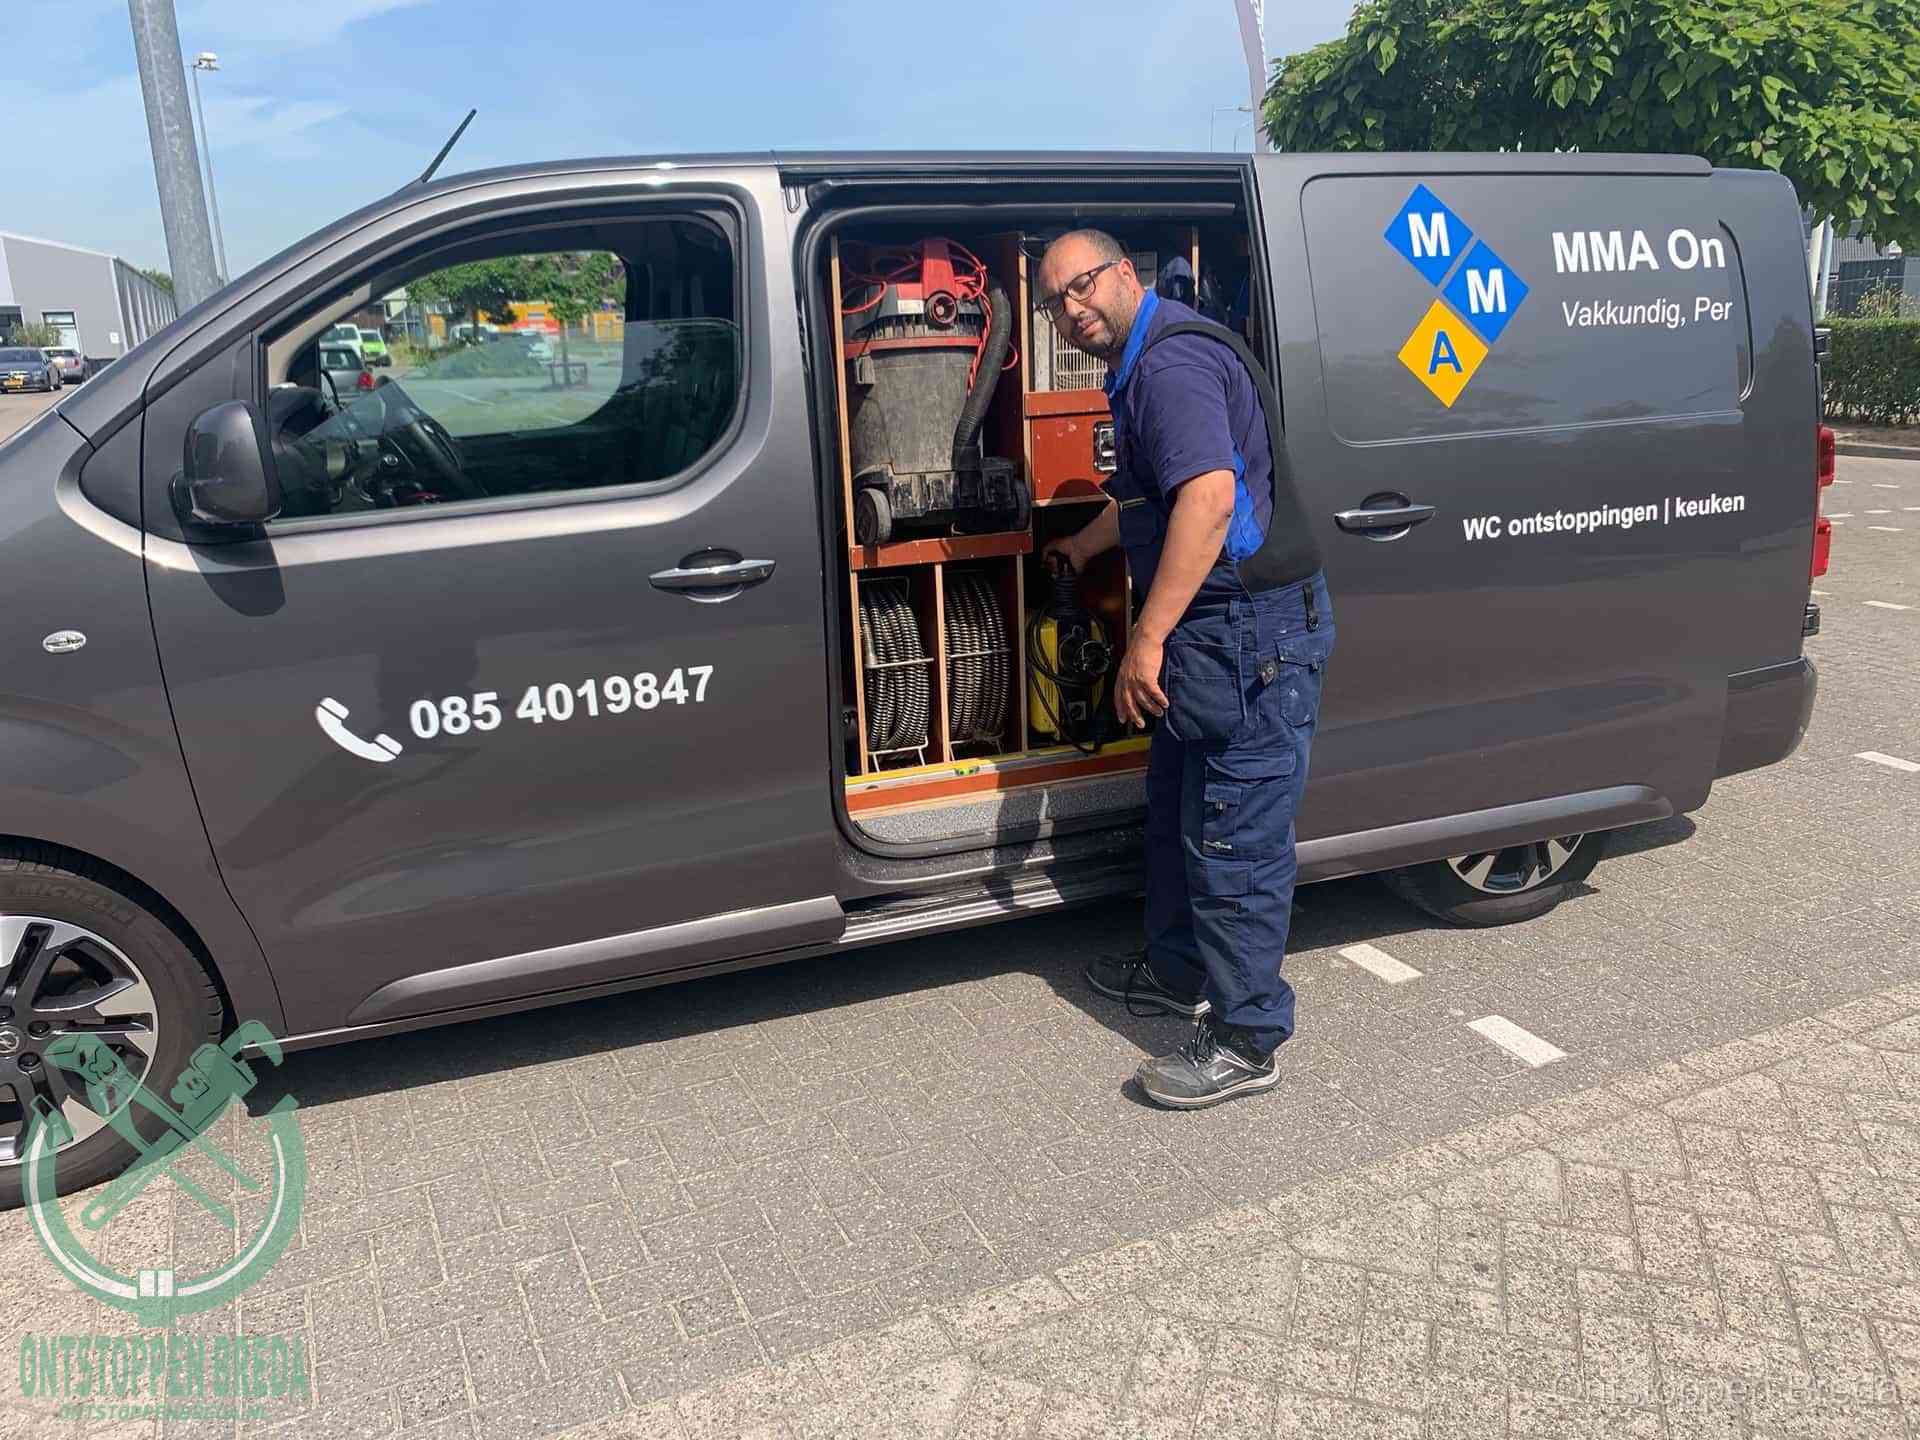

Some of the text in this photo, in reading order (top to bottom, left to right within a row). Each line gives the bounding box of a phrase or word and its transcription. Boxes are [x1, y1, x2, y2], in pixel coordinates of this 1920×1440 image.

[1407, 212, 1450, 257] M
[1551, 227, 1726, 273] MMA On
[1466, 268, 1507, 314] M
[1561, 296, 1733, 330] Vakkundig, Per
[1428, 331, 1463, 375] A
[1462, 515, 1501, 541] WC
[1508, 503, 1659, 537] ontstoppingen
[1675, 492, 1746, 520] keuken
[409, 665, 714, 739] 085 4019847
